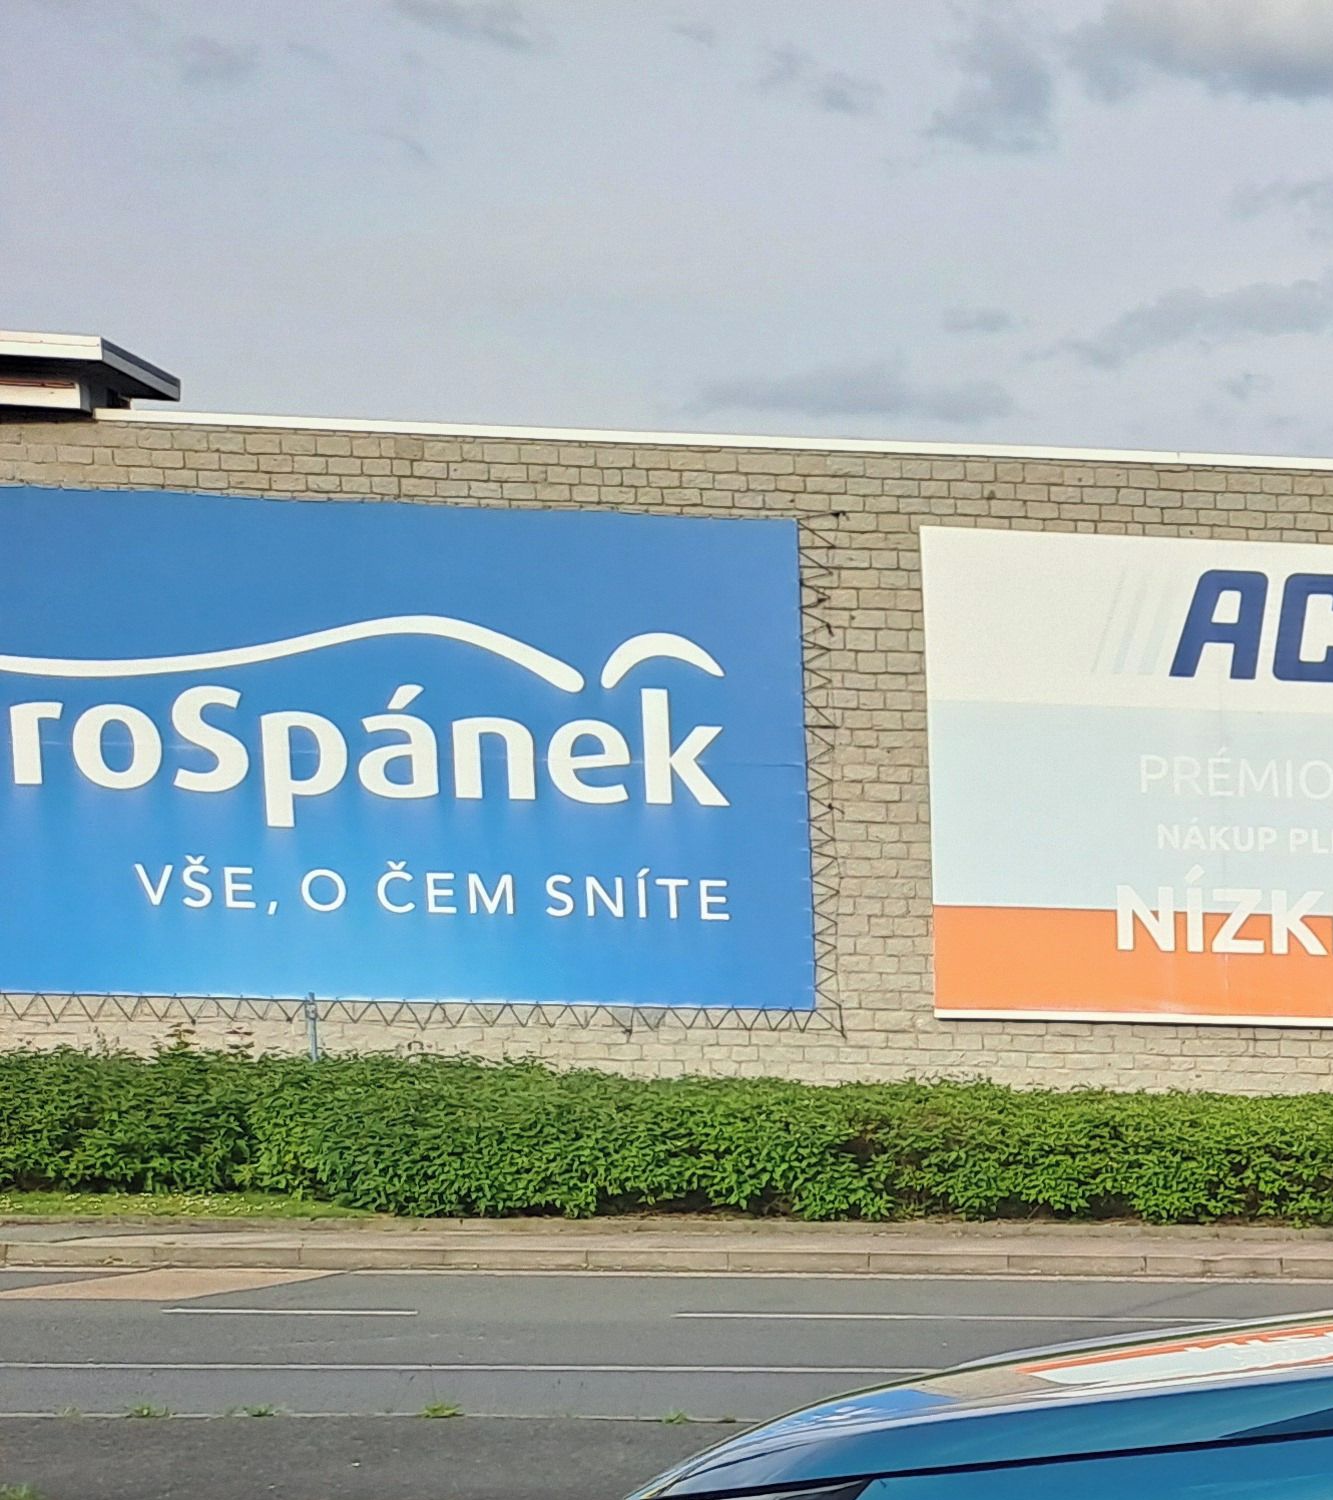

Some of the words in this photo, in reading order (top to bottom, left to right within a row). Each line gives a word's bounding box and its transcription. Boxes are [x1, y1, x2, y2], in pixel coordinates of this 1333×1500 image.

[1156, 817, 1278, 852] NÁKUP
[134, 856, 278, 915] VŠE,
[301, 869, 347, 912] O
[377, 861, 515, 915] ČEM
[545, 868, 731, 921] SNÍTE
